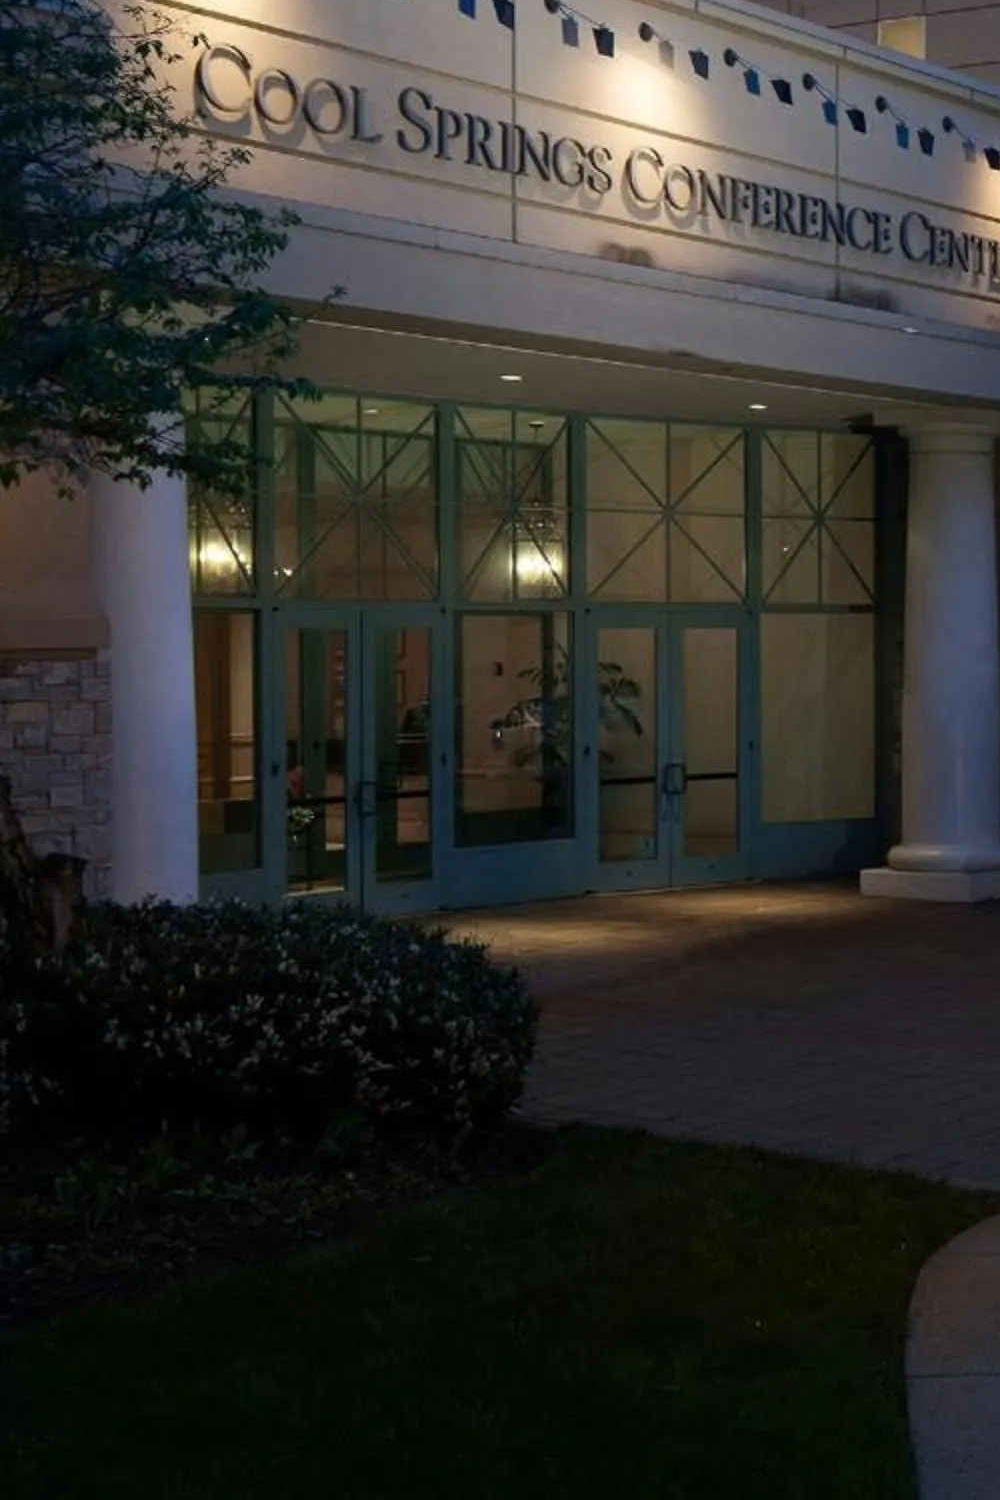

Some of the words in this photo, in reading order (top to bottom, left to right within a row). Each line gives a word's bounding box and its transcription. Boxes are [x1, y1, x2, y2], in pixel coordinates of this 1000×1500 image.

[197, 42, 383, 145] COOL
[396, 86, 613, 194] SPRINGS
[626, 146, 893, 255] CONFERENCE
